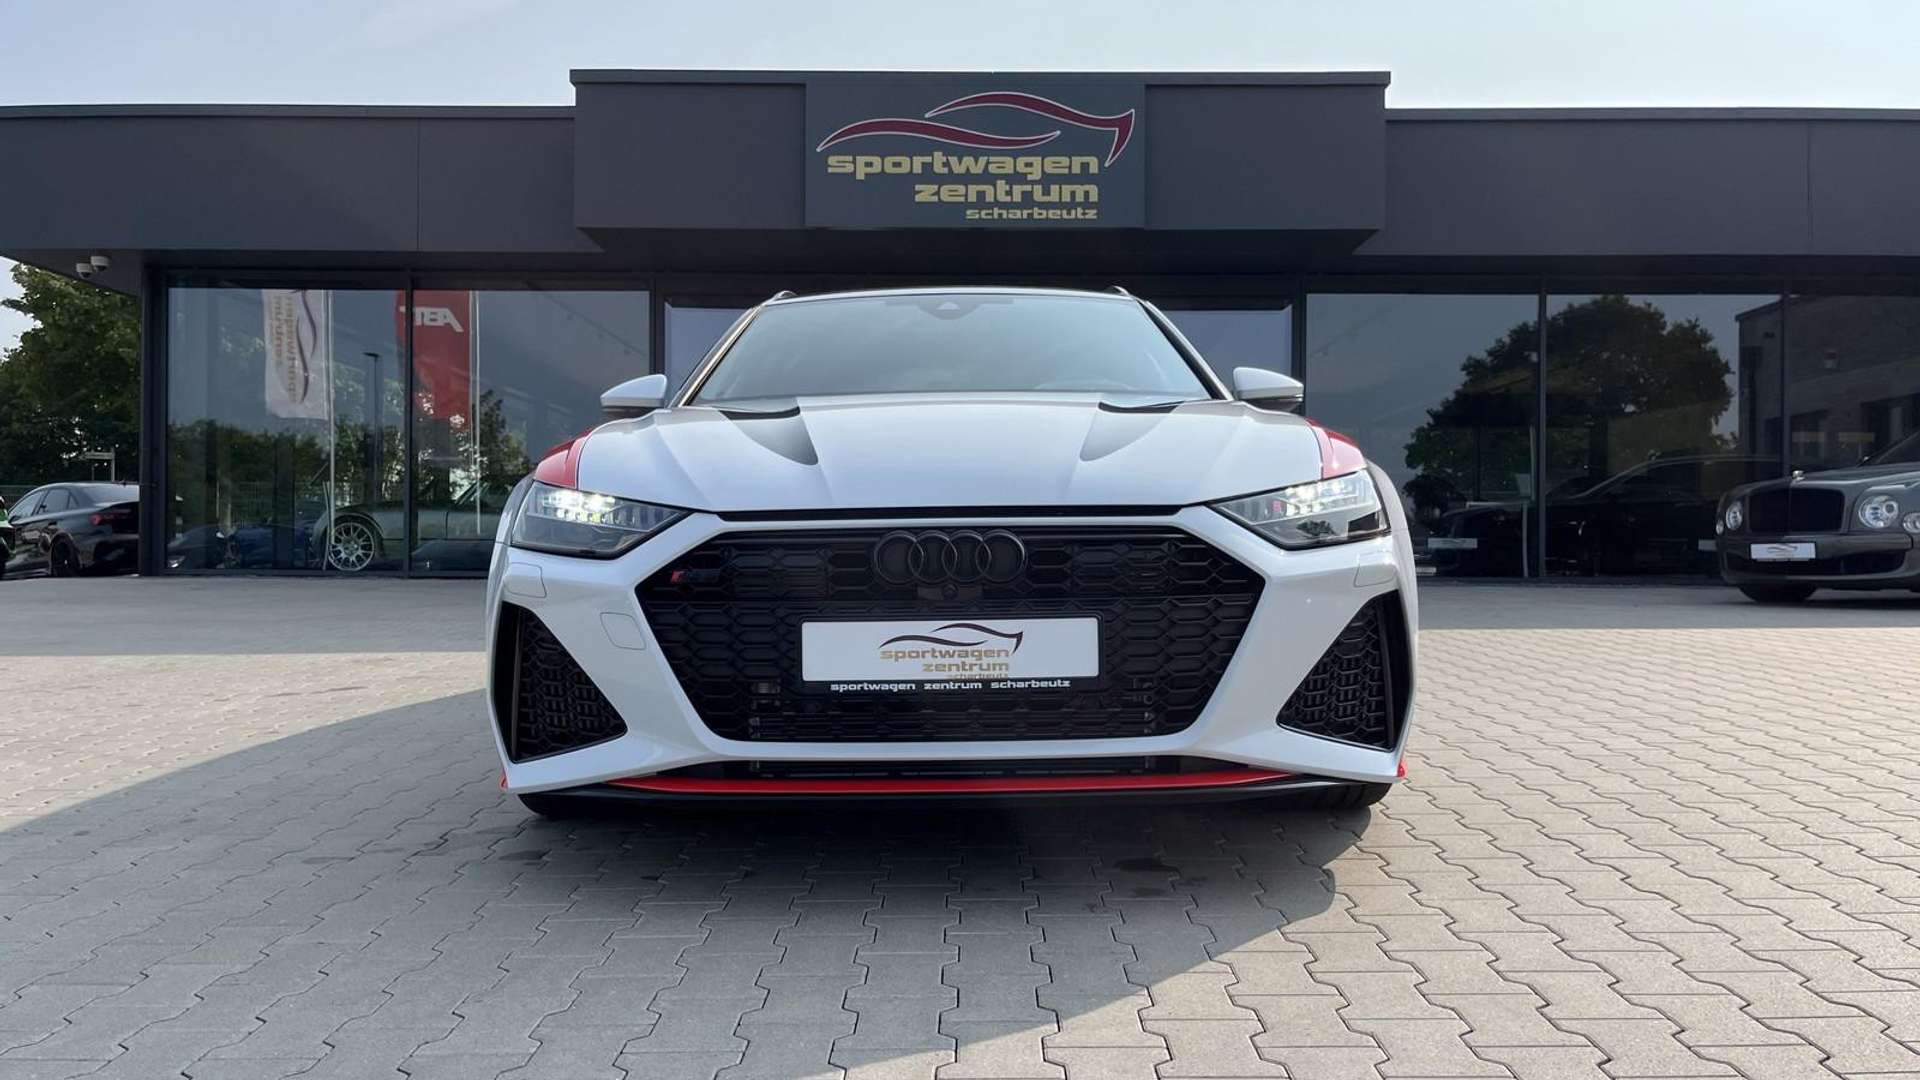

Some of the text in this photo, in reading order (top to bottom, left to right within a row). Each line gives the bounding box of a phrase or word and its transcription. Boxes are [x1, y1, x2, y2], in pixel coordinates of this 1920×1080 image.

[827, 151, 1099, 180] sportwagen
[914, 180, 1099, 203] zentrum
[965, 207, 1098, 219] scharbeutz
[880, 646, 1010, 662] sportwagen
[922, 661, 1010, 673] zentrum
[830, 679, 1071, 692] sportwagen zentrum scharbeutz
